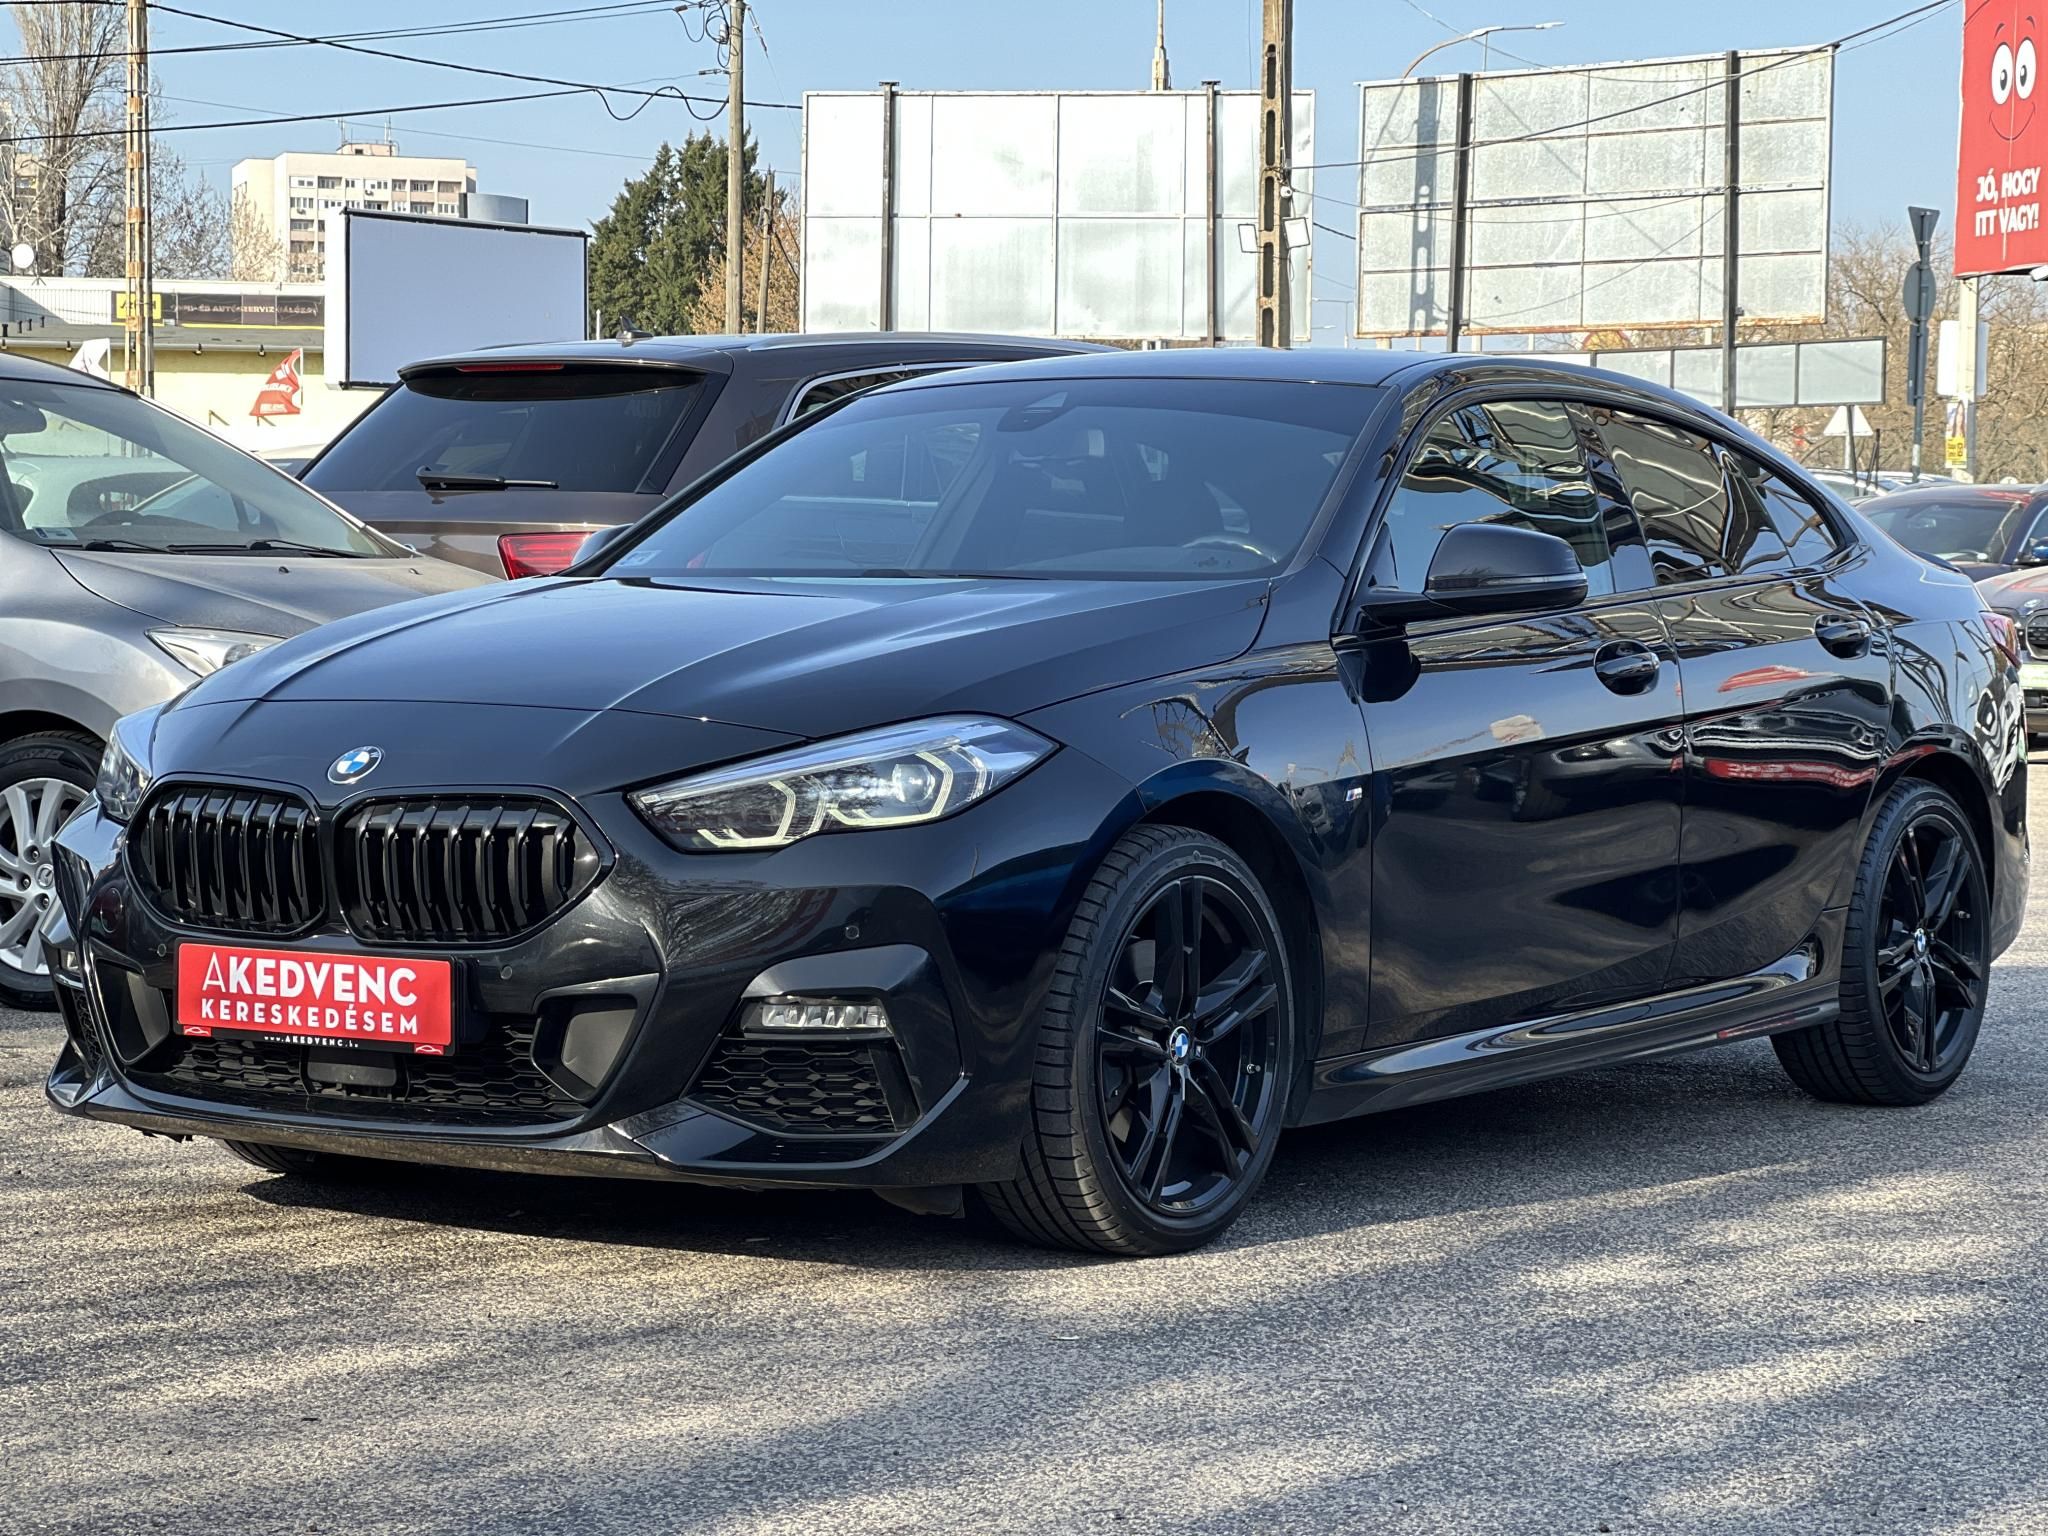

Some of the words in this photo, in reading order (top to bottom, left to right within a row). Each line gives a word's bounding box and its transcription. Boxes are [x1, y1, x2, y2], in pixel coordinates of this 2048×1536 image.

[1975, 167, 1999, 205] JÓ,
[2001, 166, 2041, 198] HOGY
[1975, 208, 1998, 237] ITT
[1998, 203, 2040, 233] VAGY!
[202, 952, 418, 1006] AKEDVENC
[201, 998, 418, 1035] KERESKEDÉSEM
